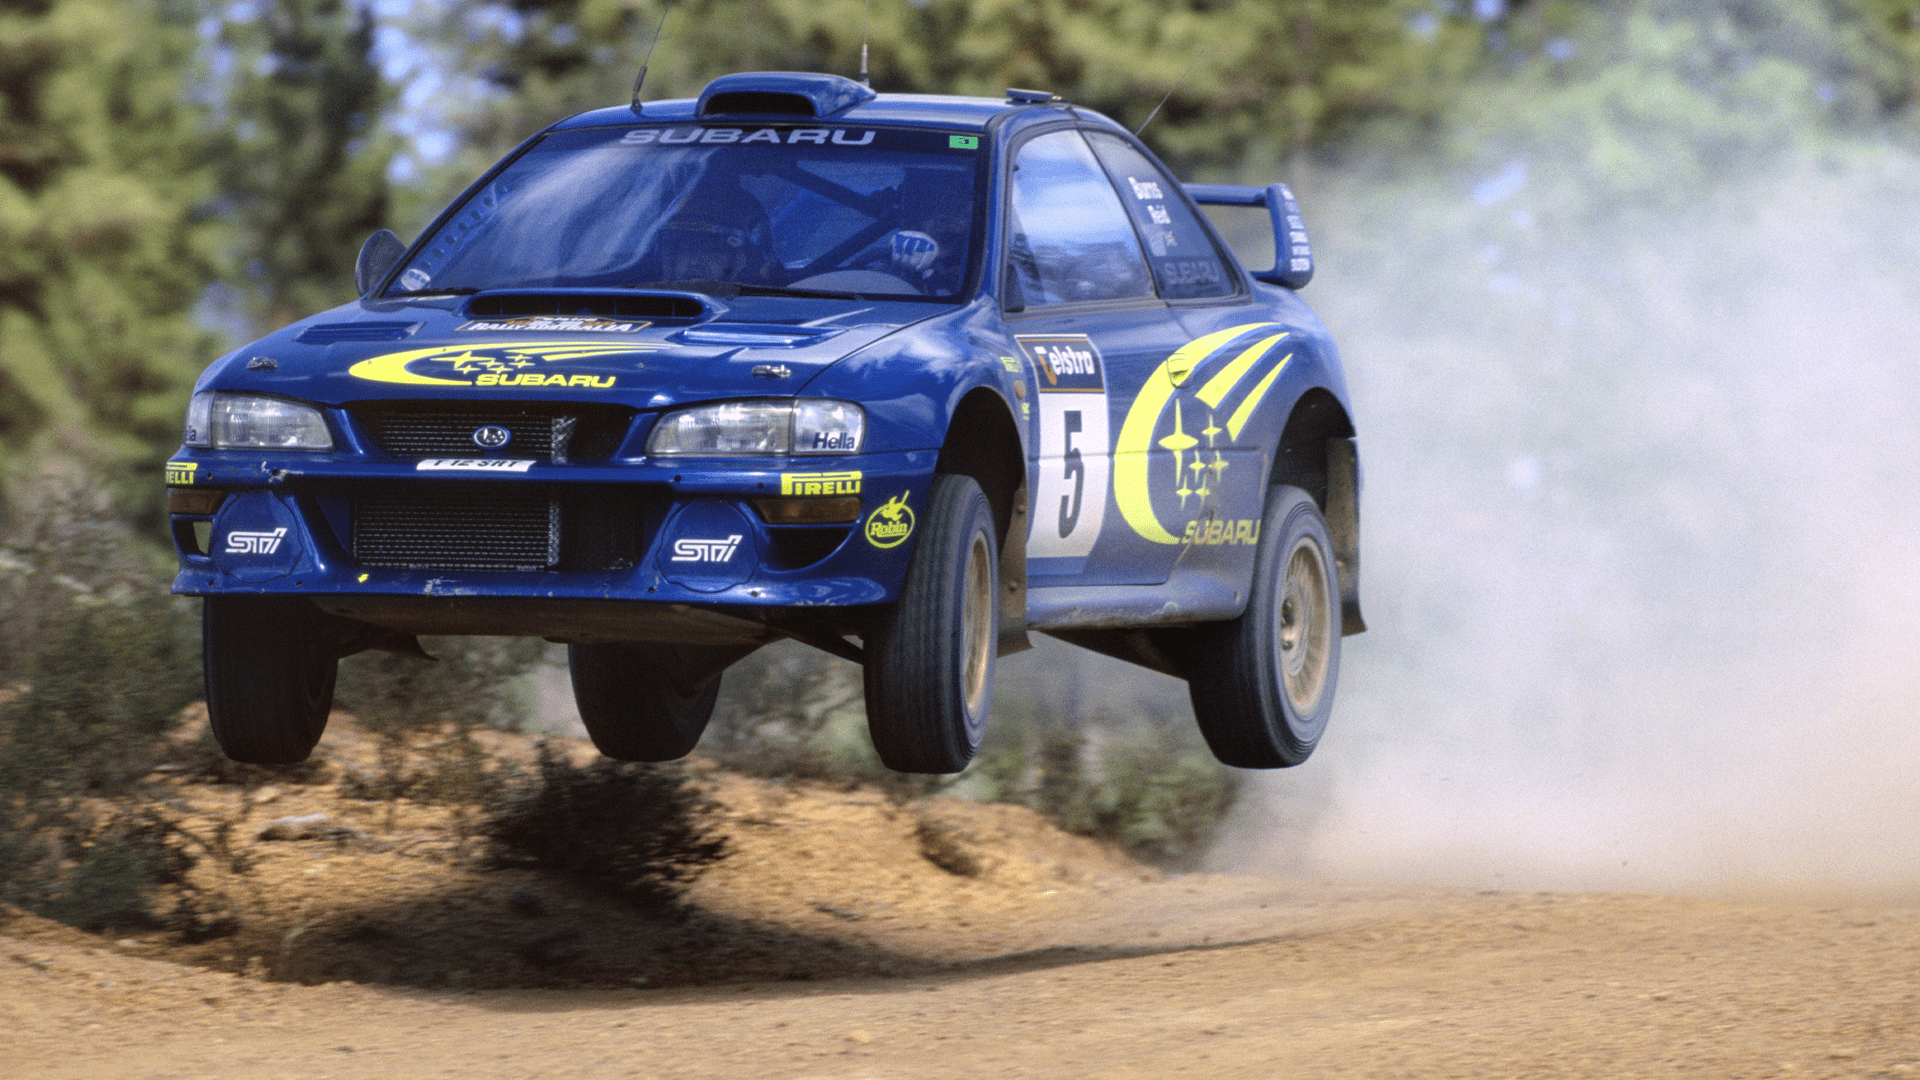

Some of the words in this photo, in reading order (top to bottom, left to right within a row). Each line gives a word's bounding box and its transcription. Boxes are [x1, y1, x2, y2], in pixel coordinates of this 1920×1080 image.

[620, 128, 876, 146] SUBARU
[475, 373, 616, 388] SUBARU
[812, 432, 855, 449] Hella
[781, 470, 862, 495] PIRELLI
[1058, 410, 1084, 539] 5
[870, 520, 908, 537] Robin
[1181, 519, 1261, 545] SUBARU
